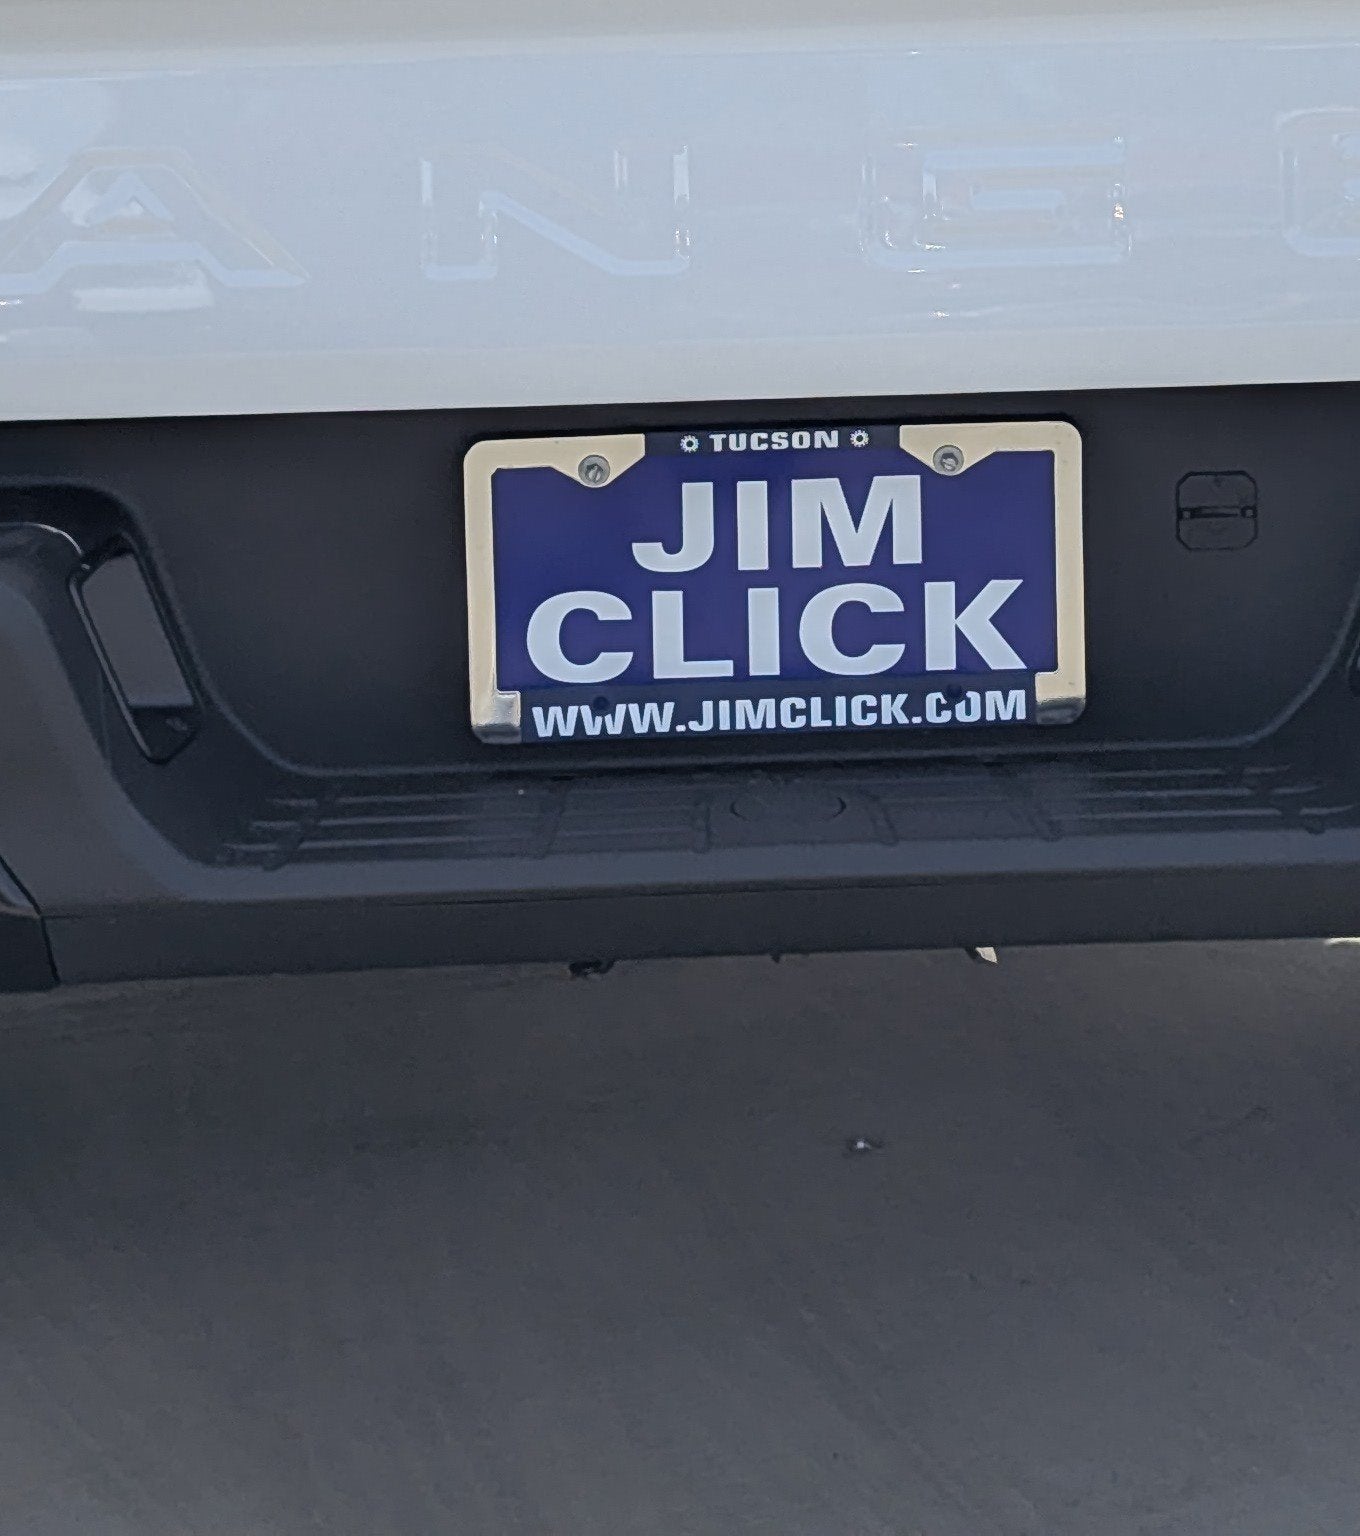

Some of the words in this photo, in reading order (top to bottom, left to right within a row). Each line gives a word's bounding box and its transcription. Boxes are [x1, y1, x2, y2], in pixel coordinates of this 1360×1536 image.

[709, 429, 840, 452] TUCSON
[631, 474, 923, 573] JIM
[526, 578, 1028, 684] CLICK
[532, 689, 1028, 738] WWW.JIMCLICK.COM
